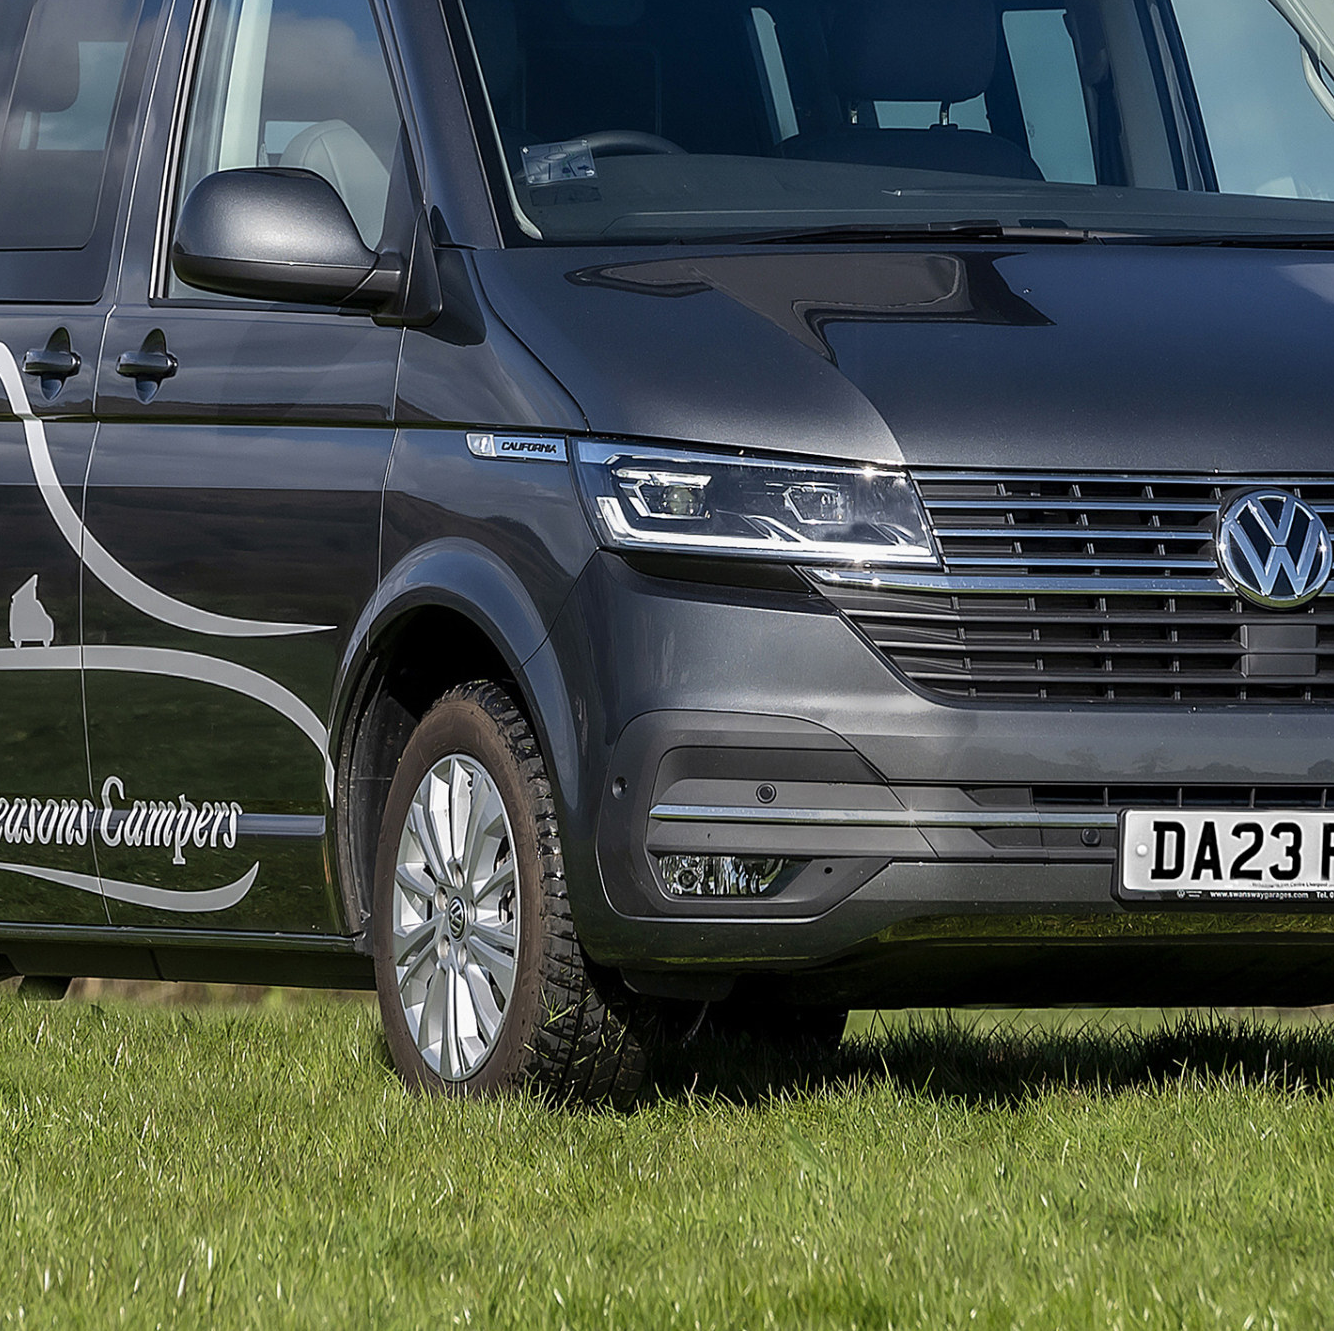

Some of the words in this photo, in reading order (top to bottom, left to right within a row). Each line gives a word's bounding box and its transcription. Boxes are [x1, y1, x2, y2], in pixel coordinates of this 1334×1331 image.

[501, 441, 557, 454] CALIFORNIA
[100, 775, 243, 865] Campers
[1150, 820, 1303, 882] DA23
